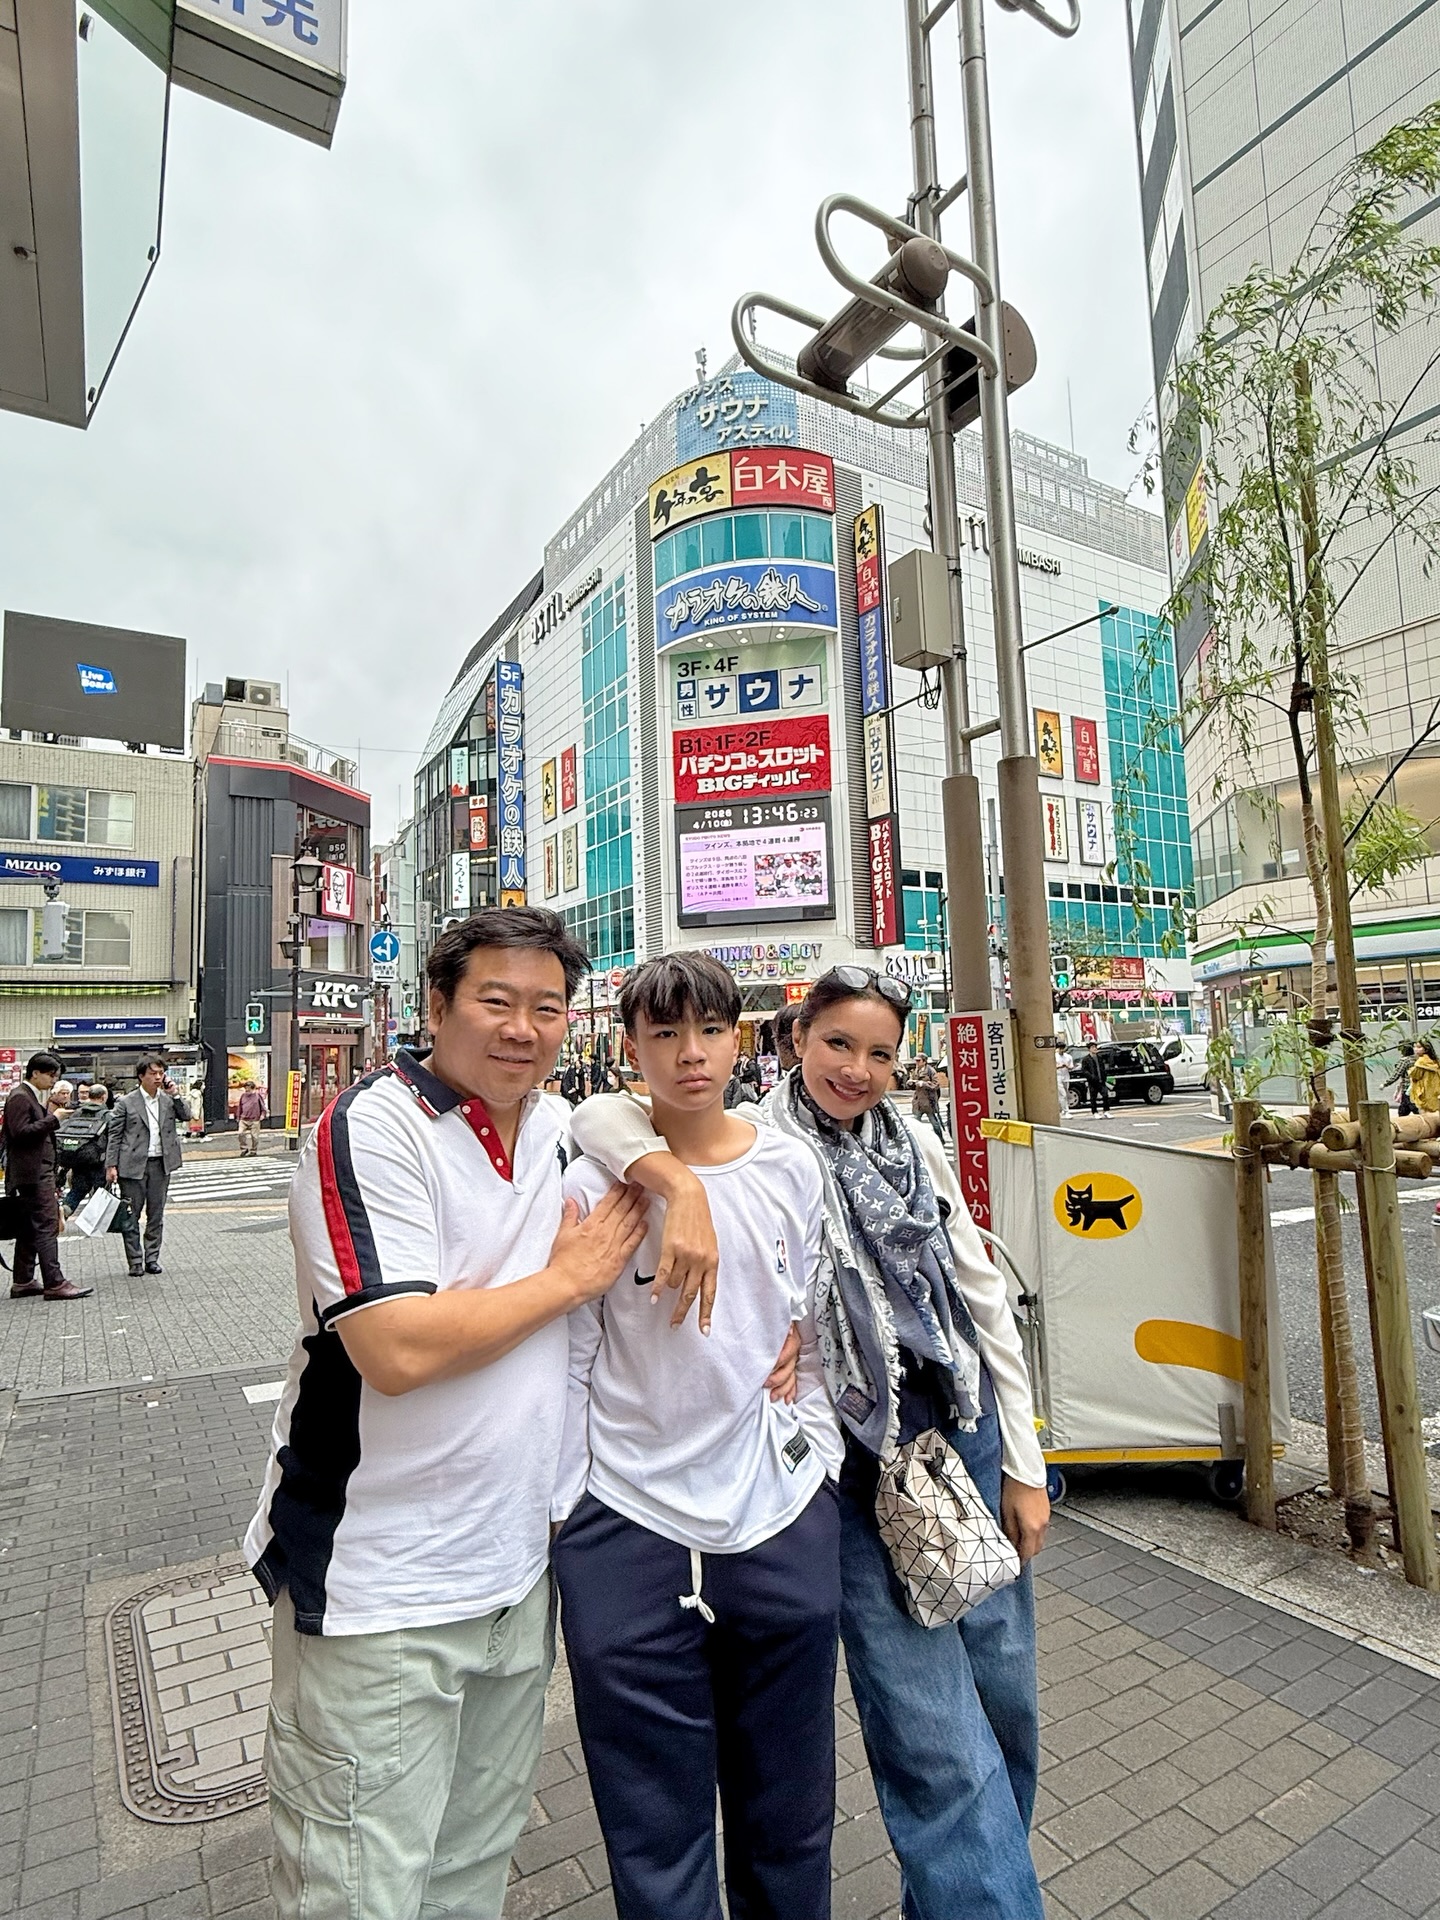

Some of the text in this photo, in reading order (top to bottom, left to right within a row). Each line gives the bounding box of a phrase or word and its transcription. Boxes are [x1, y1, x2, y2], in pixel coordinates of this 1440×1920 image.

[697, 395, 769, 428] サウナ
[734, 457, 831, 498] 白木屋
[665, 567, 822, 631] カラオケの鉄人
[704, 611, 778, 626] KING OF SYSTEM
[81, 670, 104, 681] Live
[500, 665, 520, 682] 5F
[864, 612, 881, 713] カラオケの鉄人
[81, 678, 114, 691] Board
[704, 673, 814, 710] サウナ
[679, 743, 825, 776] パチンコ&スロット
[870, 737, 883, 790] サウナ
[500, 684, 524, 888] カラオケの鉄人
[697, 771, 812, 794] BIGディッパー
[5, 858, 62, 872] MIZUHO
[93, 866, 147, 878] みずほ銀行
[870, 825, 885, 944] BIGディッパー
[312, 981, 359, 1009] KFC
